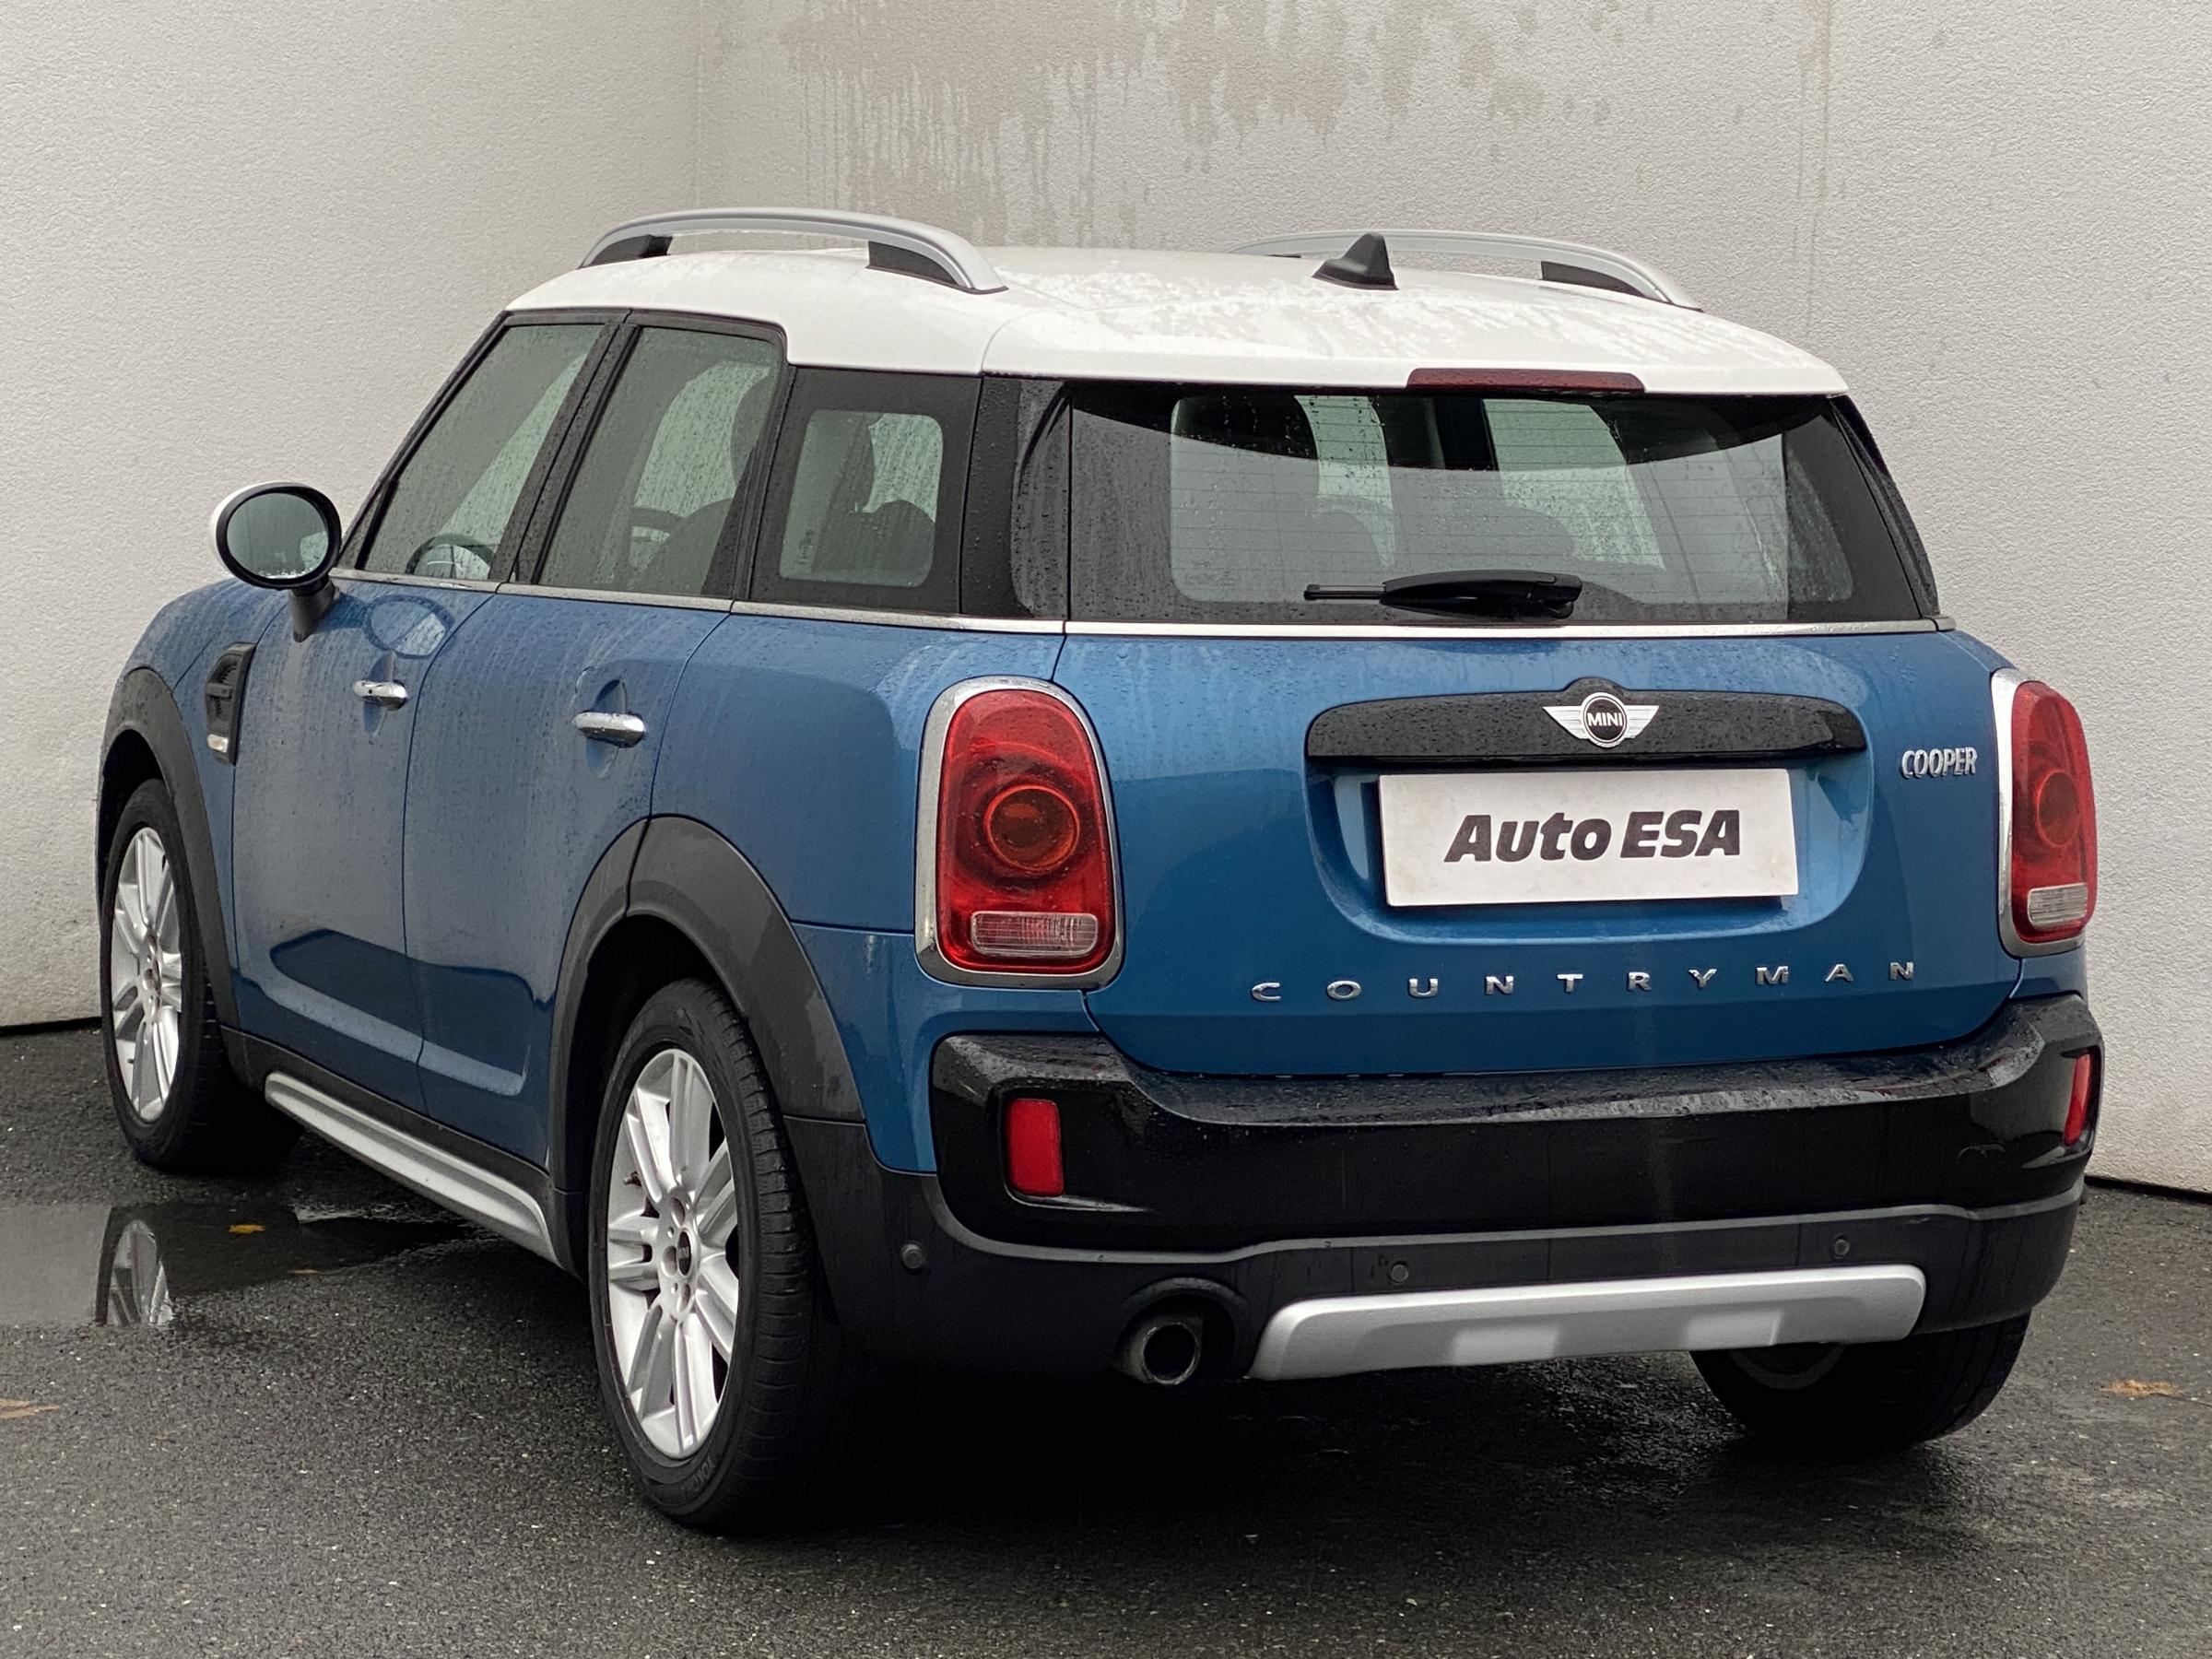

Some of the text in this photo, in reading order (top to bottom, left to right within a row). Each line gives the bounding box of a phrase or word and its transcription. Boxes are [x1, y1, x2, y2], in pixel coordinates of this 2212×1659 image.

[1586, 712, 1622, 726] MINI
[1901, 747, 1978, 779] COOPER
[1443, 809, 1741, 863] Auto ESA
[1251, 961, 1914, 1002] COUNTRYMAN
